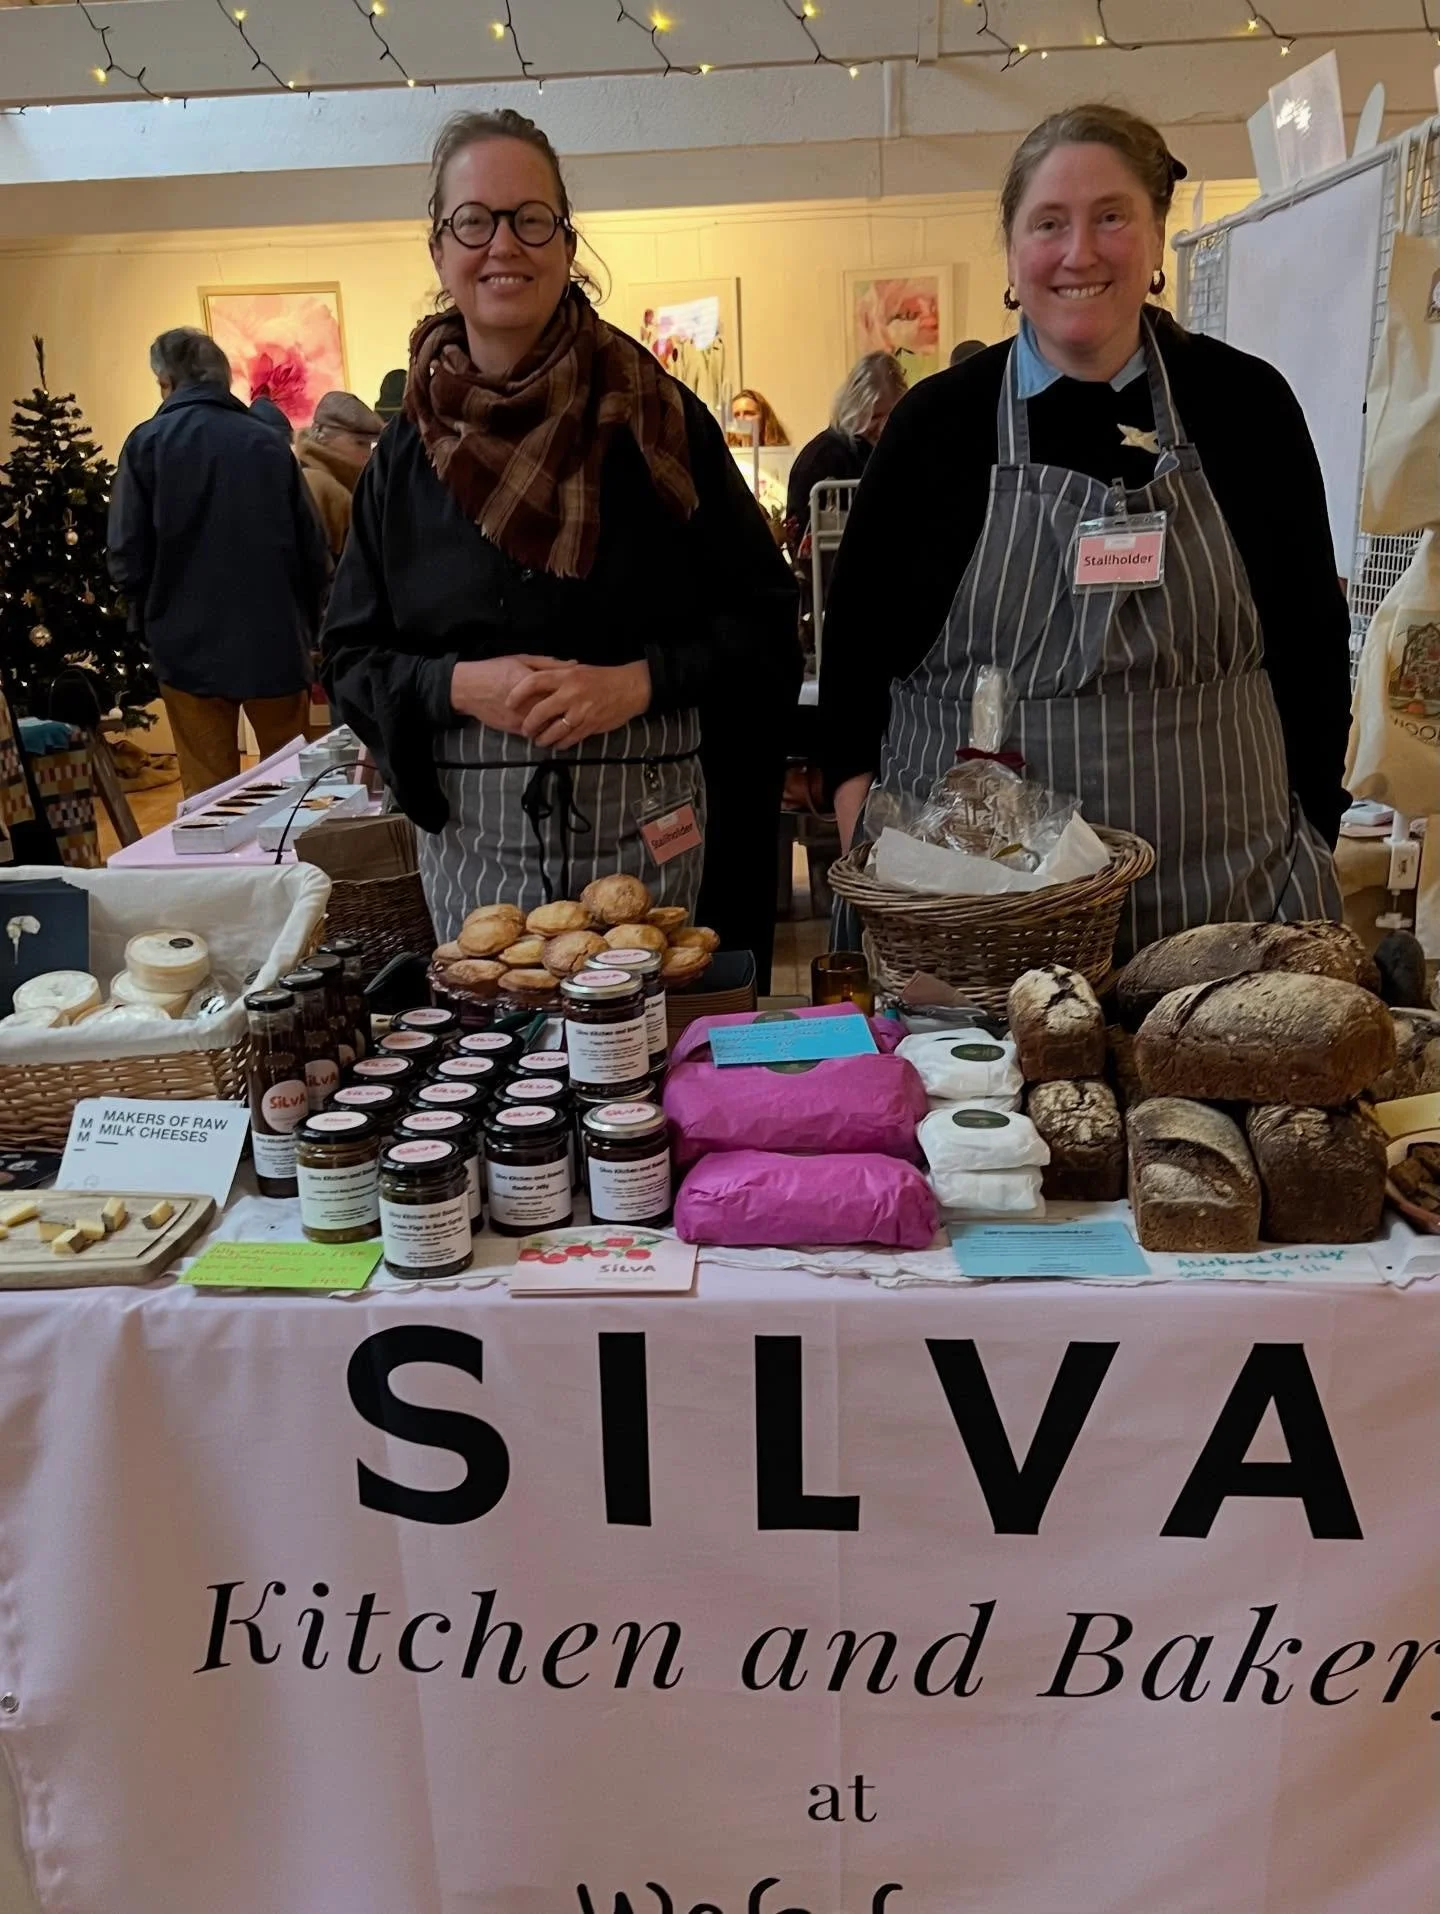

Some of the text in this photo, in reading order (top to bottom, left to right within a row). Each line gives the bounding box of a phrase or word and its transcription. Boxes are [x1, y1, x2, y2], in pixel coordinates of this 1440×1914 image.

[1084, 552, 1154, 567] Stallholder
[651, 822, 694, 850] Stallholder
[80, 1118, 94, 1130] M
[103, 1110, 229, 1130] MAKERS OF RAW
[77, 1131, 91, 1143] M
[99, 1124, 209, 1143] MILK CHEESES
[347, 1325, 1363, 1540] SILVA
[194, 1579, 1440, 1722] Kitchen and Baker
[808, 1775, 877, 1824] at
